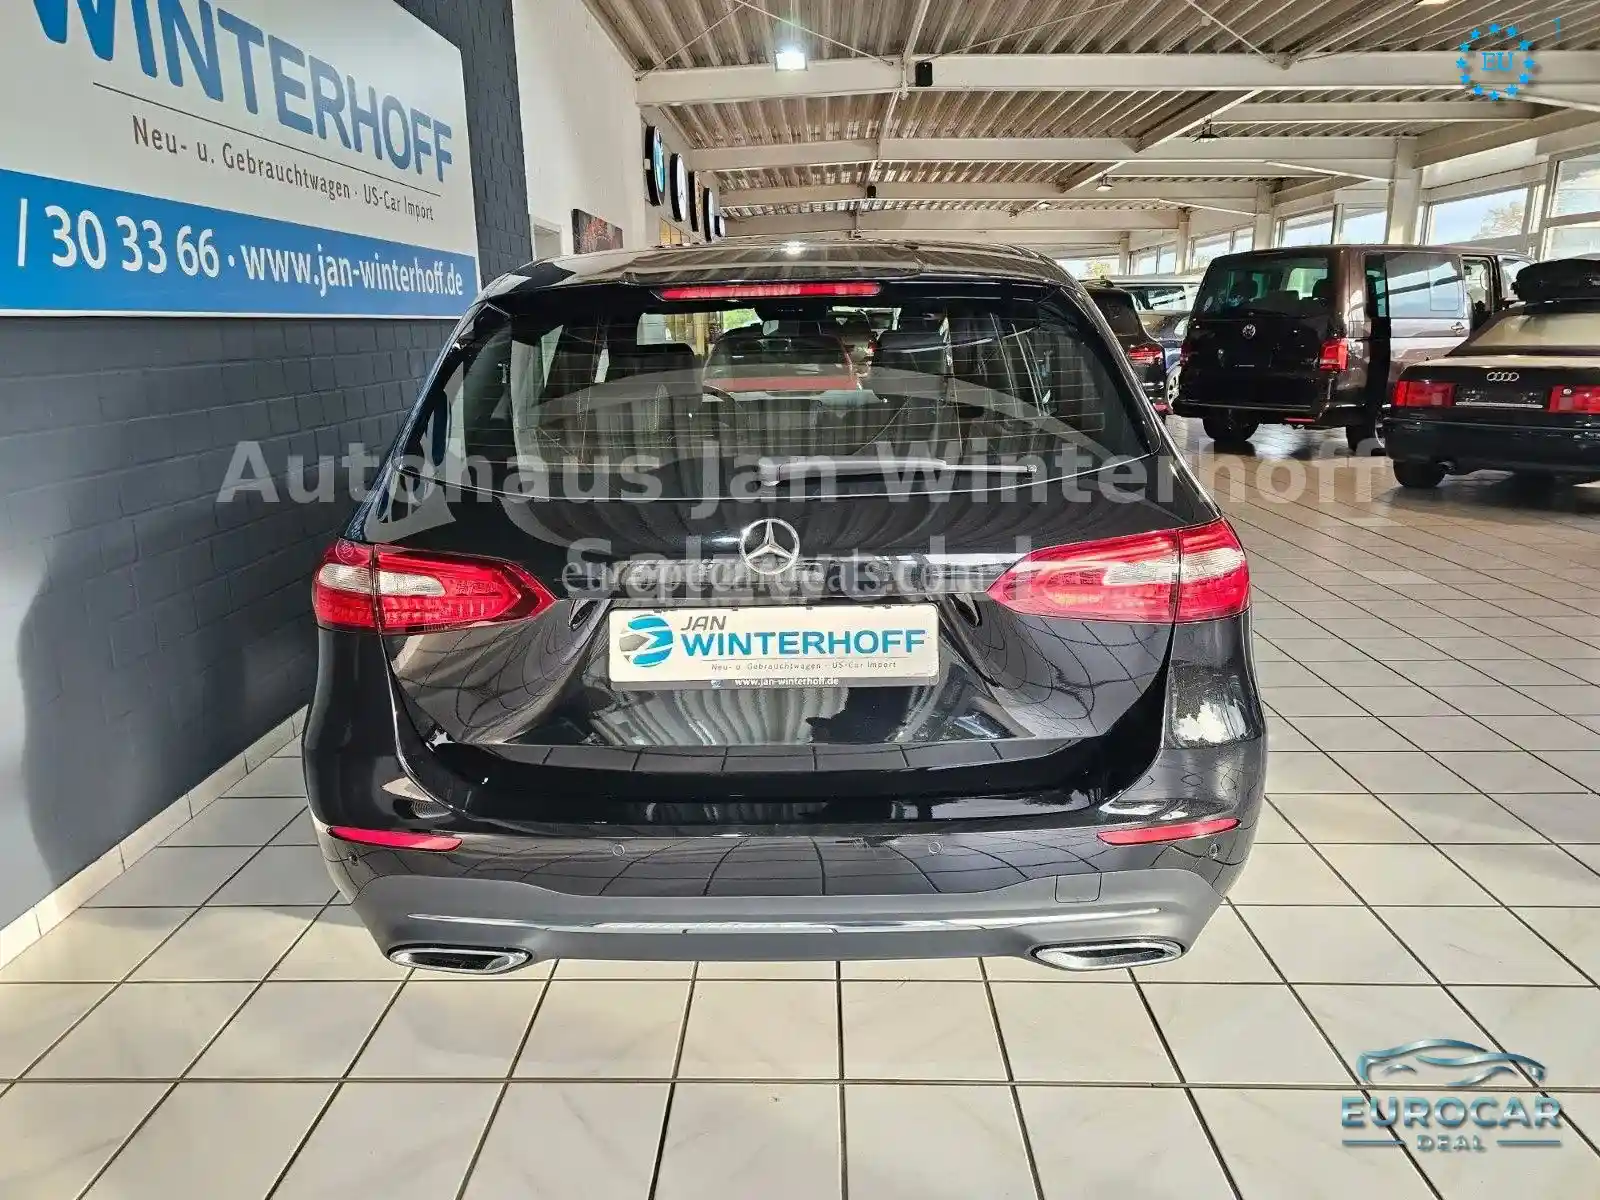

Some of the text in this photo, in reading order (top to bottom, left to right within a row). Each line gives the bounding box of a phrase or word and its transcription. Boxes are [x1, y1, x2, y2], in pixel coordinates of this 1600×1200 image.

[132, 114, 434, 221] Neu- u. Gebrauchtwagen US-Car Import
[44, 205, 107, 270] 30
[115, 215, 168, 274] 33
[176, 225, 220, 278] 66
[240, 243, 464, 297] www.jan-winterhoff.de
[680, 615, 727, 631] JAN
[680, 629, 926, 657] WINTERHOFF
